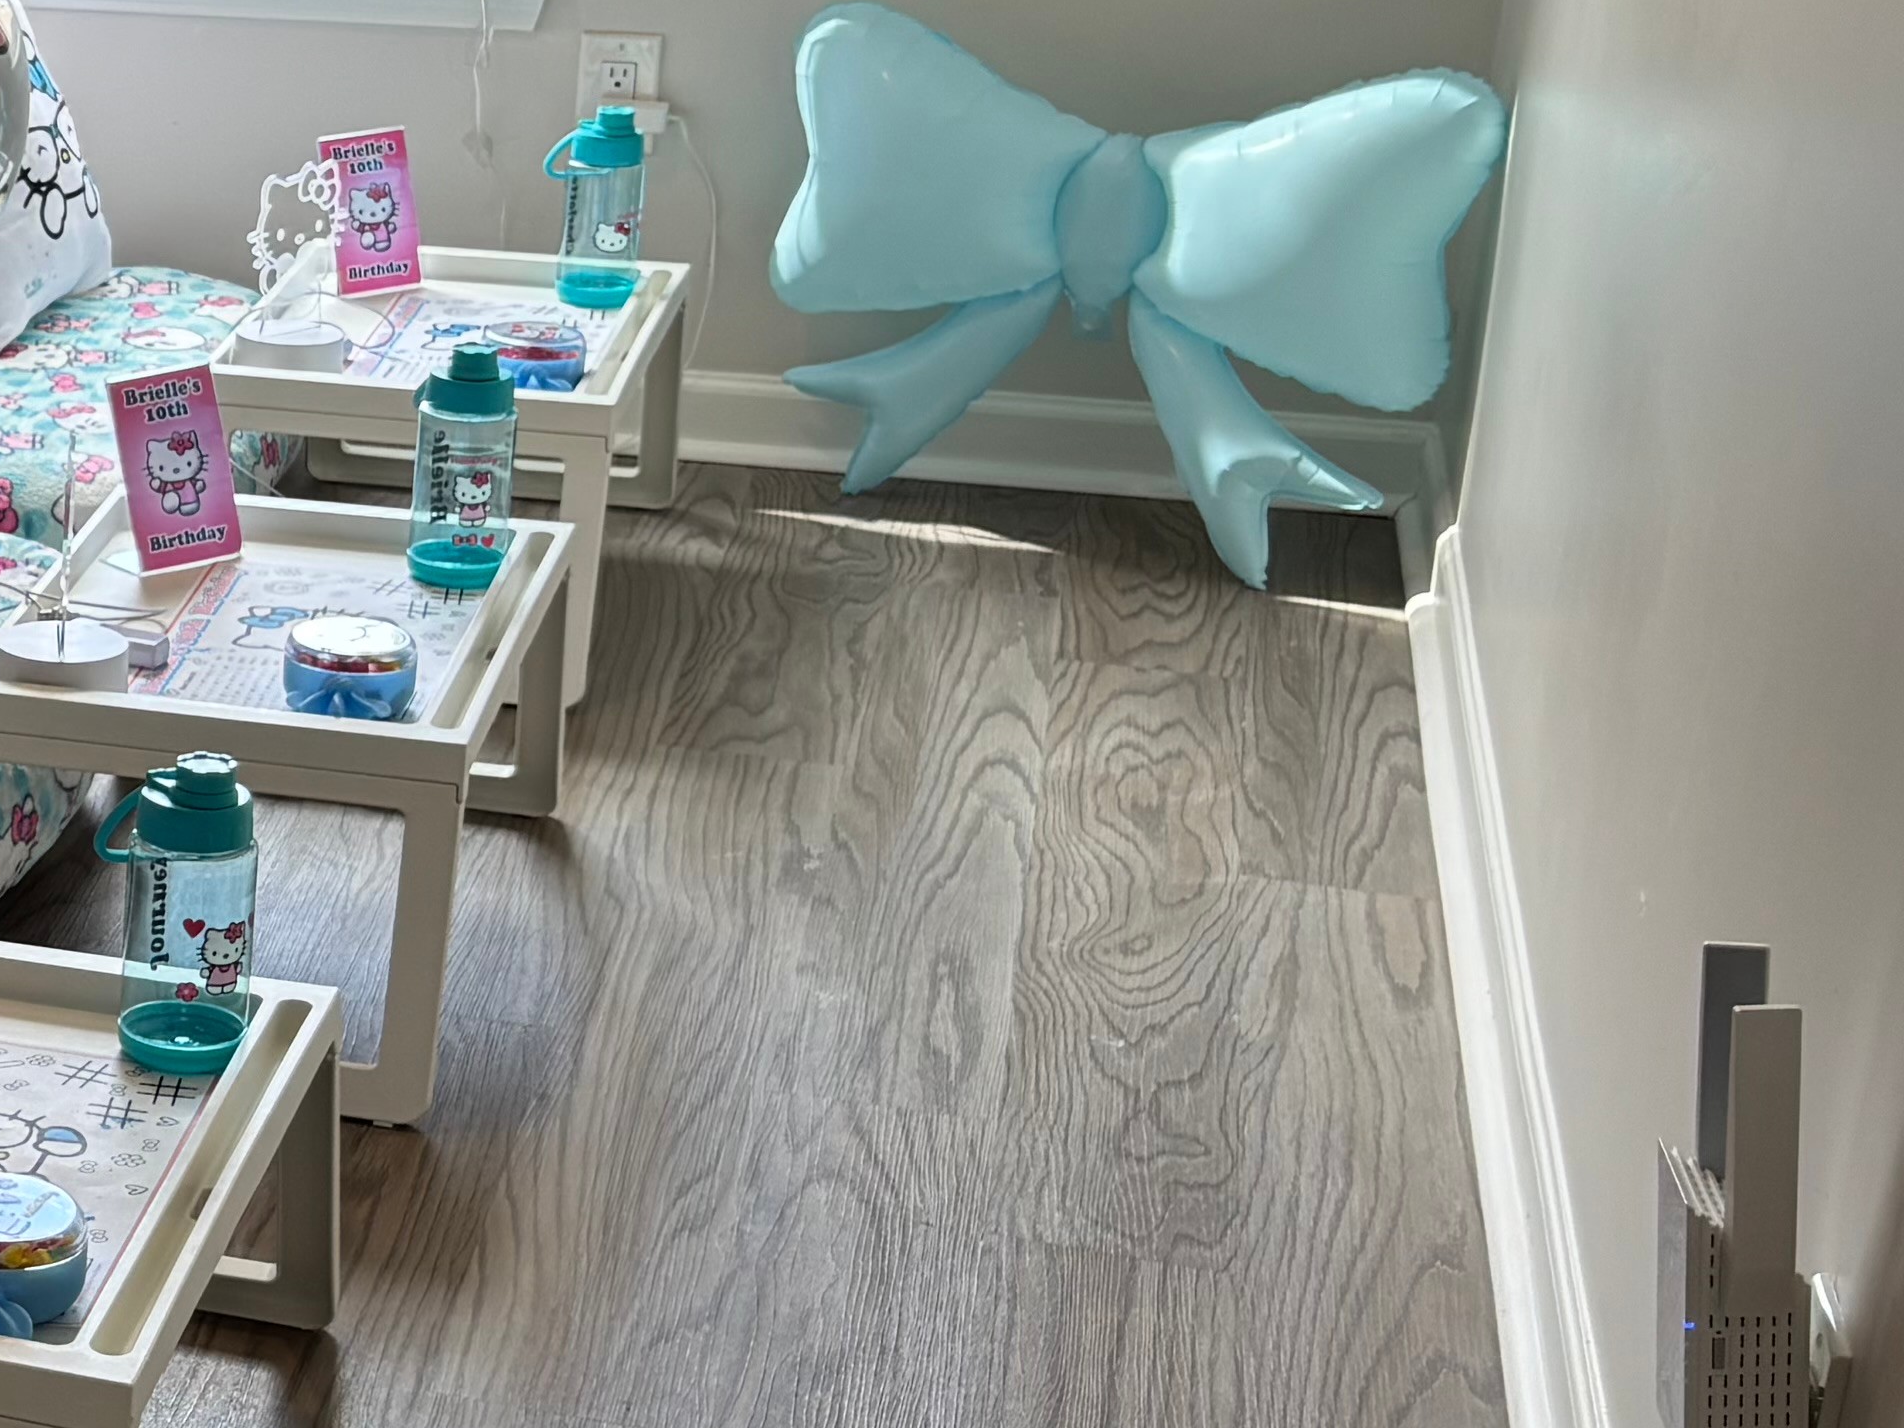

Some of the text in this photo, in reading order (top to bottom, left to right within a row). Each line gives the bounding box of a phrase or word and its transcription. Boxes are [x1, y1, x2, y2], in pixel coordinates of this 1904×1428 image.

[332, 141, 395, 160] Brielle's
[349, 159, 383, 174] 10th
[348, 262, 409, 280] Birthday
[123, 378, 201, 406] Brielle's
[145, 401, 189, 423] 10th
[149, 525, 226, 553] Birthday
